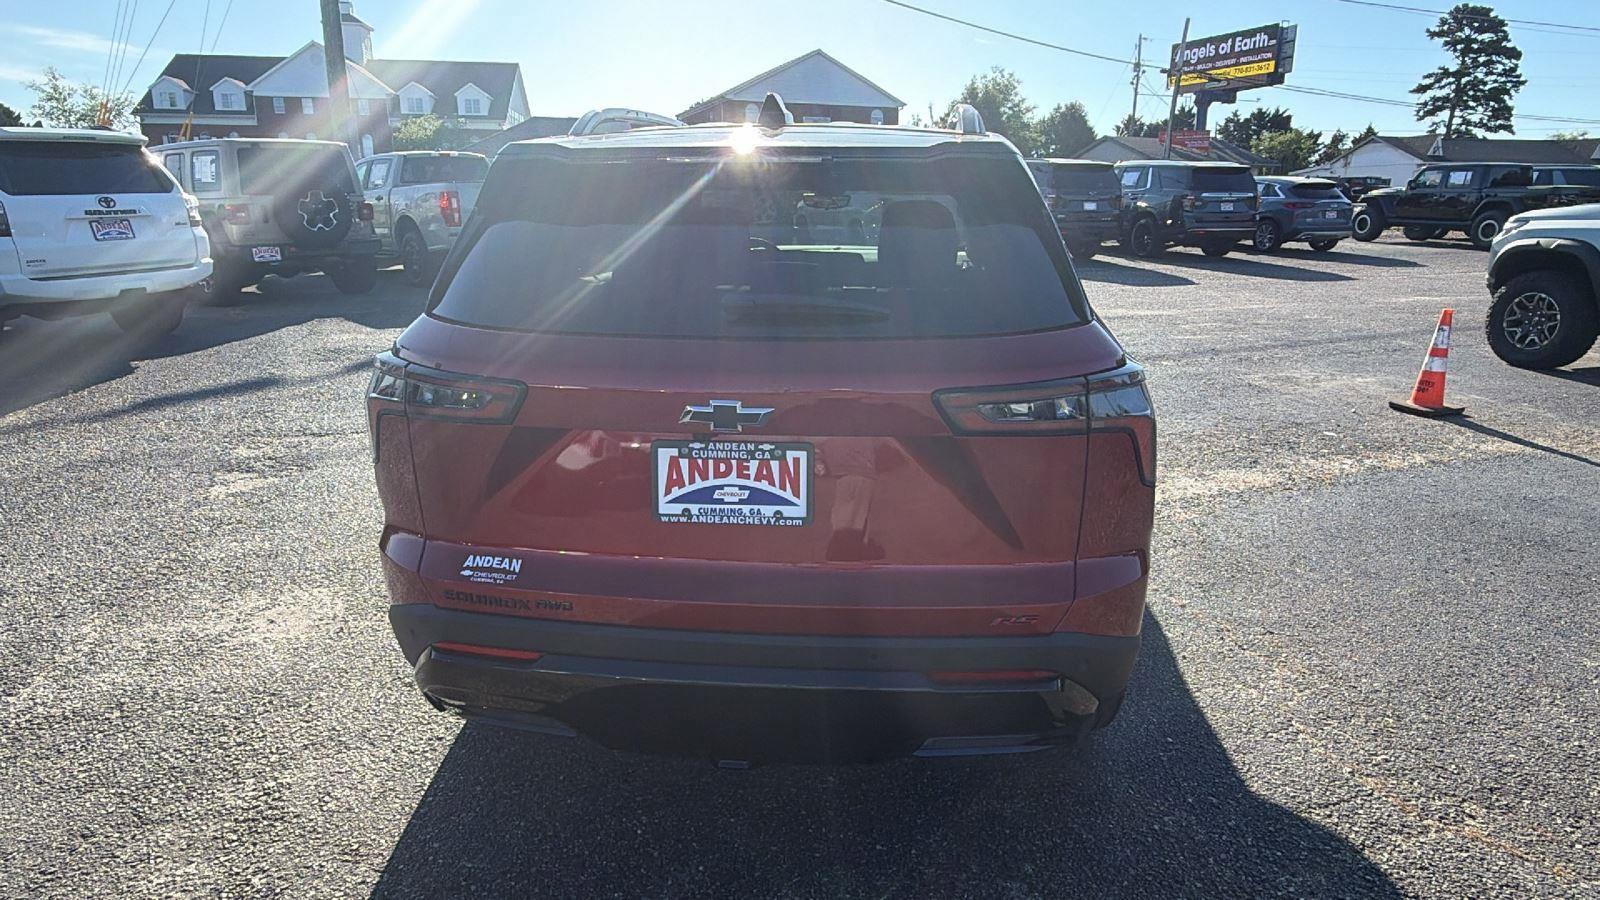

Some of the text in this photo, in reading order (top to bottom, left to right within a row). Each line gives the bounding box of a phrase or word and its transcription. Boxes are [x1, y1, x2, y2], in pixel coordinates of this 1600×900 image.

[1219, 38, 1232, 54] of
[1240, 53, 1272, 63] INSTALLATION
[708, 442, 755, 451] ANDEAN
[692, 450, 771, 460] CUMMING, GA
[664, 456, 800, 500] ANDEAN
[715, 490, 747, 498] CHEVROLET
[698, 507, 766, 517] CUMMING, GA.
[660, 514, 803, 526] www.ANDEANCHEVY.com
[463, 555, 522, 572] ANDEAN
[473, 570, 517, 580] CHEVROLET
[444, 589, 531, 611] EQUINOX
